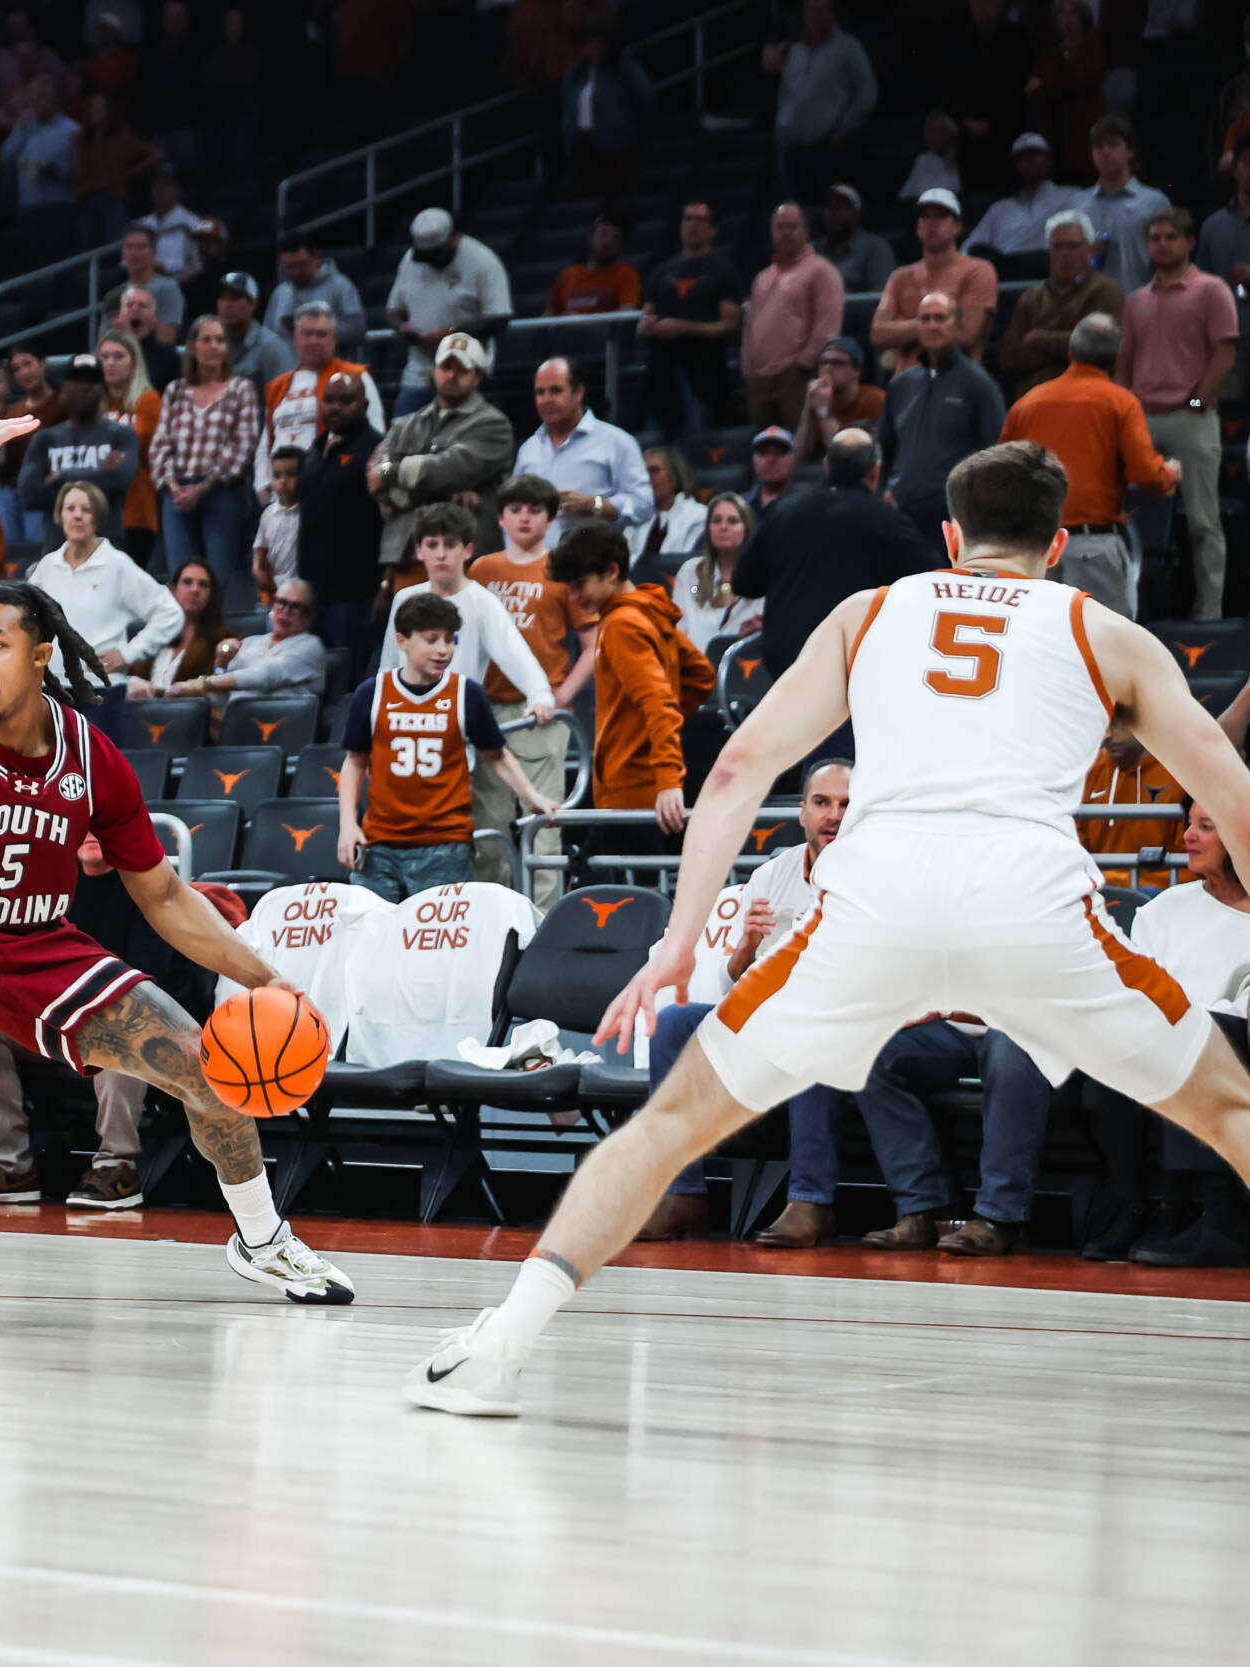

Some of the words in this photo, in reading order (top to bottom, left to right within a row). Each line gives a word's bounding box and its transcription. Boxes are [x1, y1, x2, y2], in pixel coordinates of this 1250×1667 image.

[932, 582, 1030, 608] HEIDE
[922, 609, 1010, 701] 5
[387, 711, 449, 732] TEXAS
[390, 737, 443, 777] 35
[60, 773, 85, 800] SEC
[284, 898, 338, 922] OUR
[416, 900, 470, 924] OUR
[271, 921, 334, 949] VEINS
[403, 926, 470, 951] VEINS
